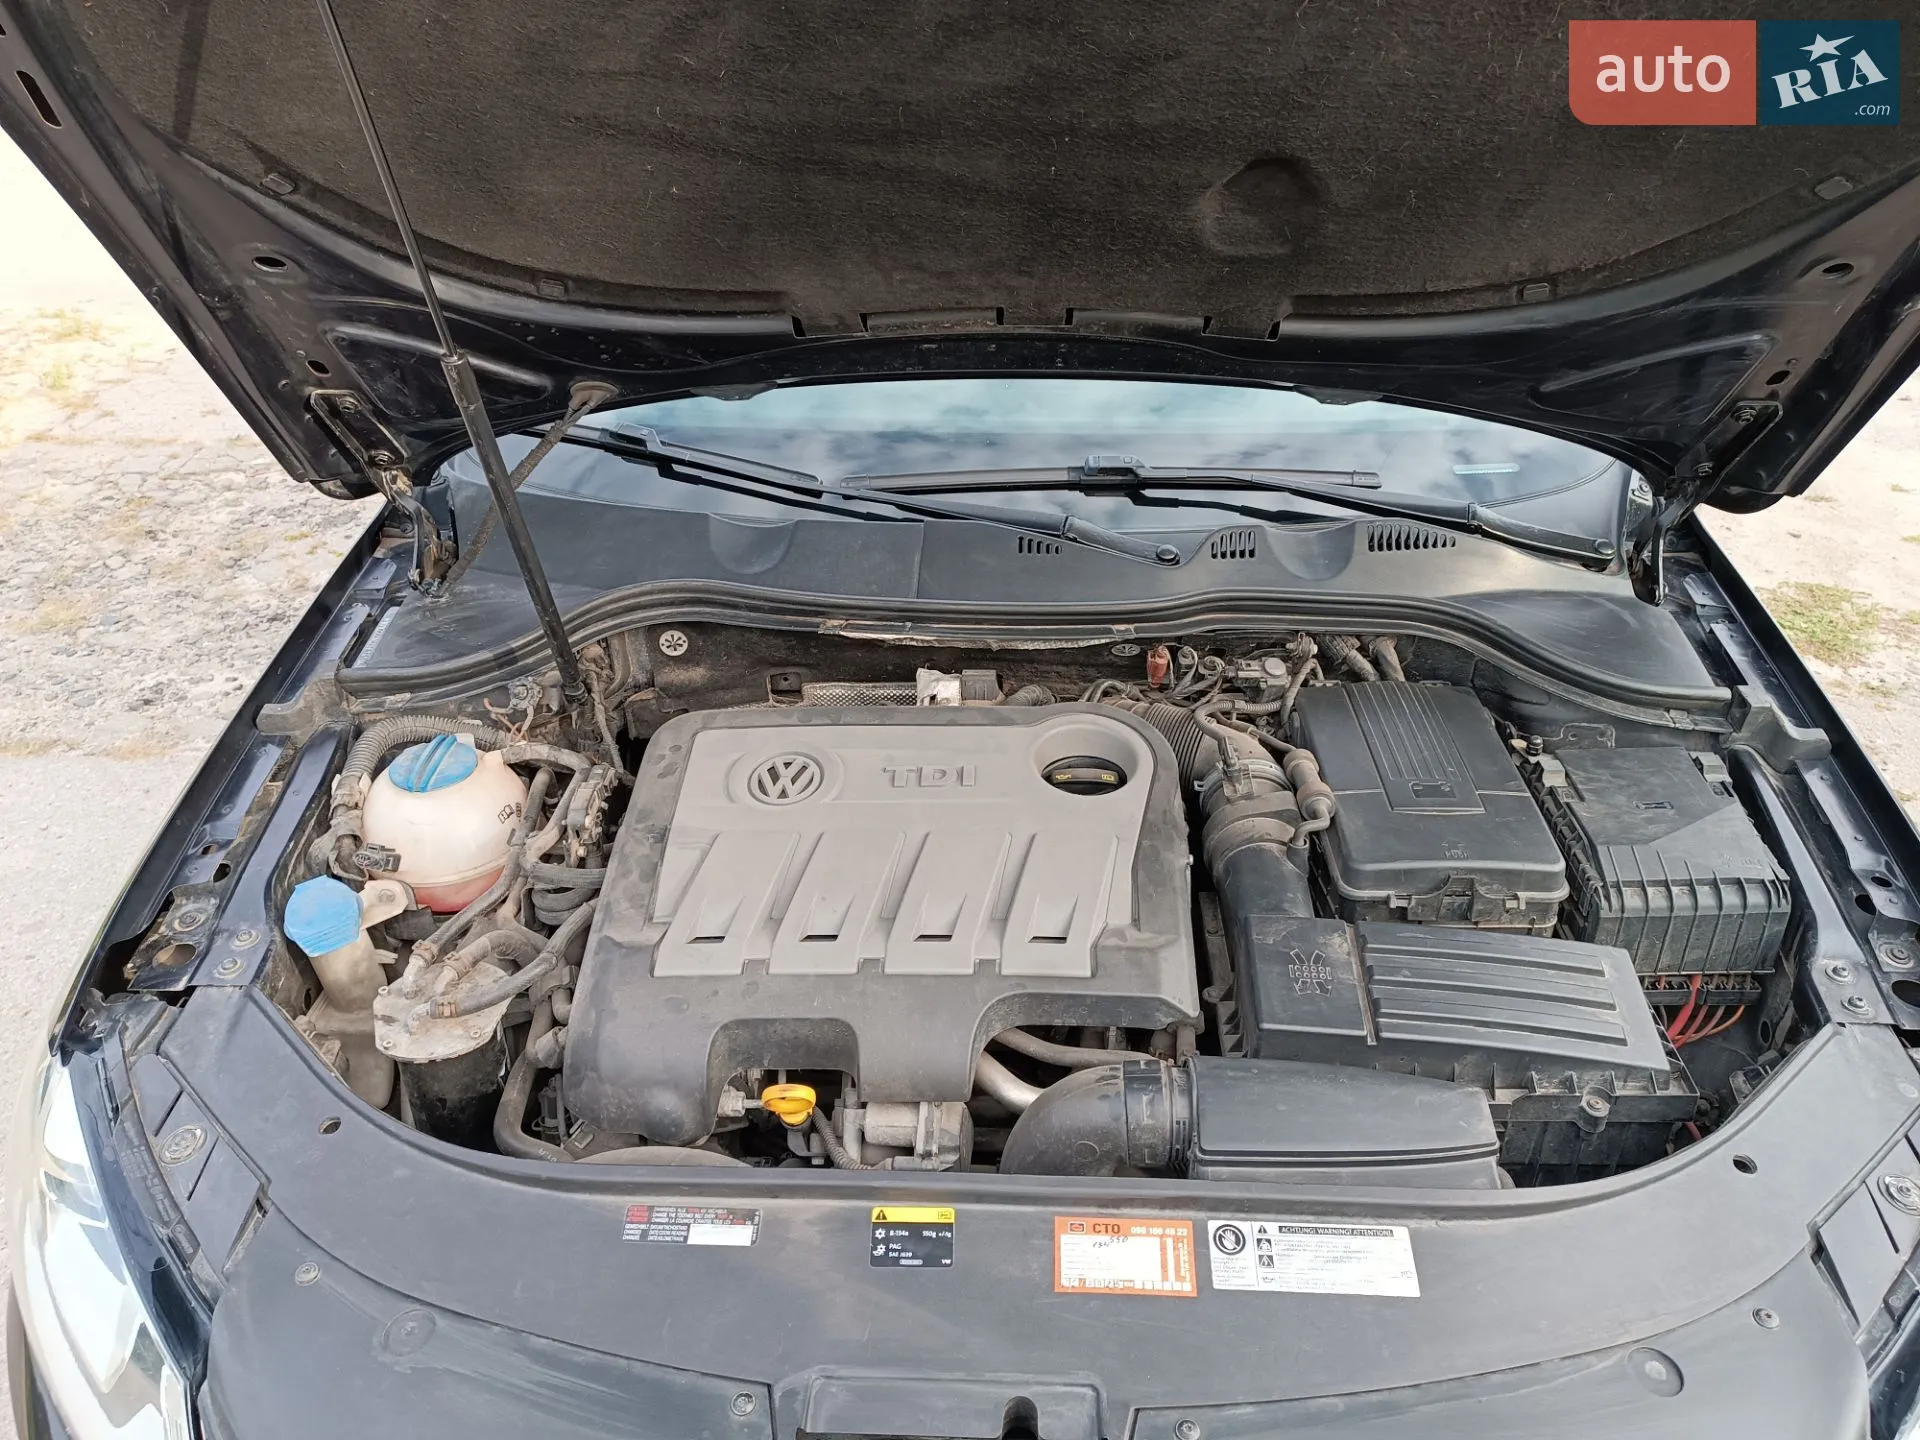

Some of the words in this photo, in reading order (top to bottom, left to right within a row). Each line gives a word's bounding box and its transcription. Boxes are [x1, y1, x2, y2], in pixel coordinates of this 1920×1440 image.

[881, 765, 977, 788] TDI
[1281, 1226, 1316, 1235] ACHTUNG!
[1317, 1228, 1353, 1236] WARNING!
